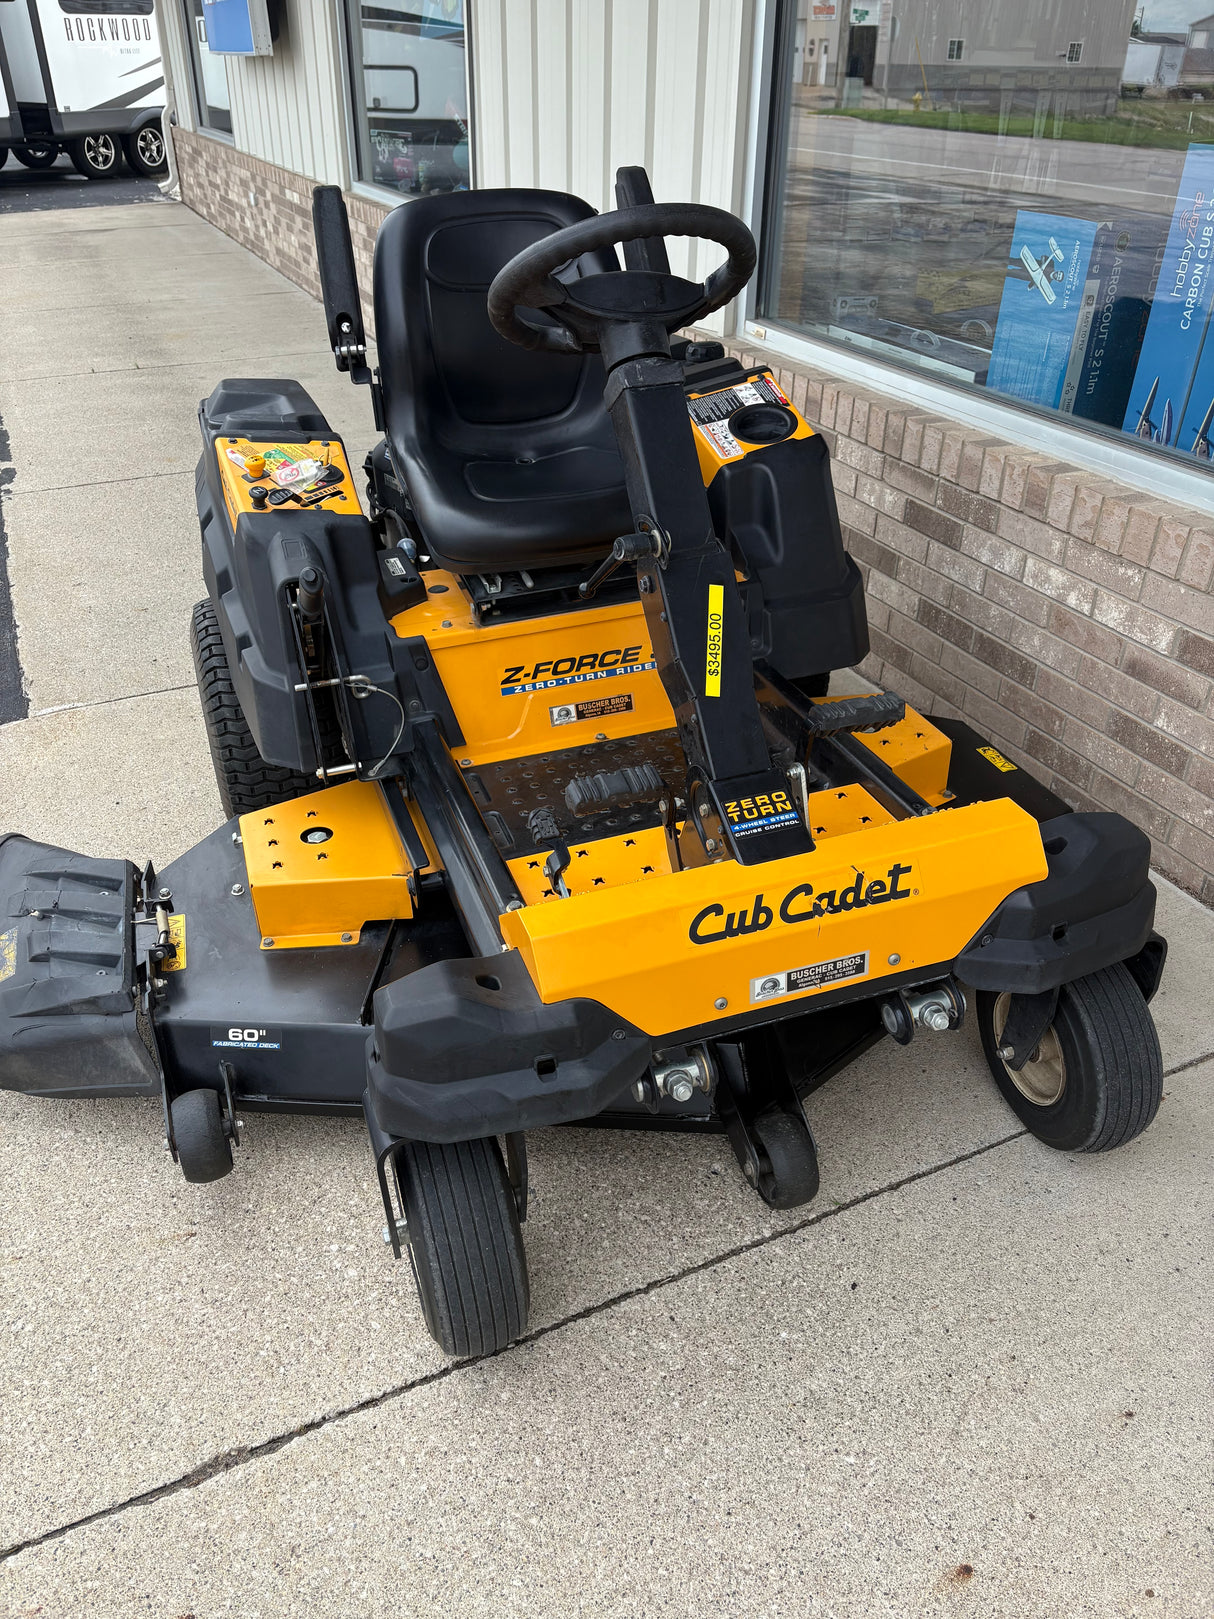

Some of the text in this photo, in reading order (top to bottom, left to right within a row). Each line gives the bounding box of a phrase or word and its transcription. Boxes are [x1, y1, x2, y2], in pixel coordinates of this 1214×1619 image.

[64, 18, 151, 41] ROCKWOOD
[1170, 192, 1205, 297] hobbyzone
[1068, 240, 1080, 282] AEROSCOUT
[1180, 264, 1204, 330] CARBON
[1198, 226, 1214, 259] CUB
[1082, 311, 1091, 327] EASY
[1081, 330, 1086, 338] TO
[1094, 350, 1104, 358] S
[1086, 371, 1100, 395] 1.1m
[708, 613, 722, 676] $3495.00
[501, 645, 642, 685] Z-FORCE
[616, 662, 658, 675] RIDE
[578, 699, 610, 712] BUSCHER
[610, 696, 631, 706] BROS.
[725, 792, 786, 812] ZERO
[728, 800, 792, 822] TURN
[734, 813, 796, 830] 4-WHEEL STEER
[734, 820, 800, 838] CRUISE CONTROL
[689, 863, 912, 944] Cub Cadet
[791, 956, 864, 980] BUSCHER BROS.
[228, 1028, 266, 1042] 60"
